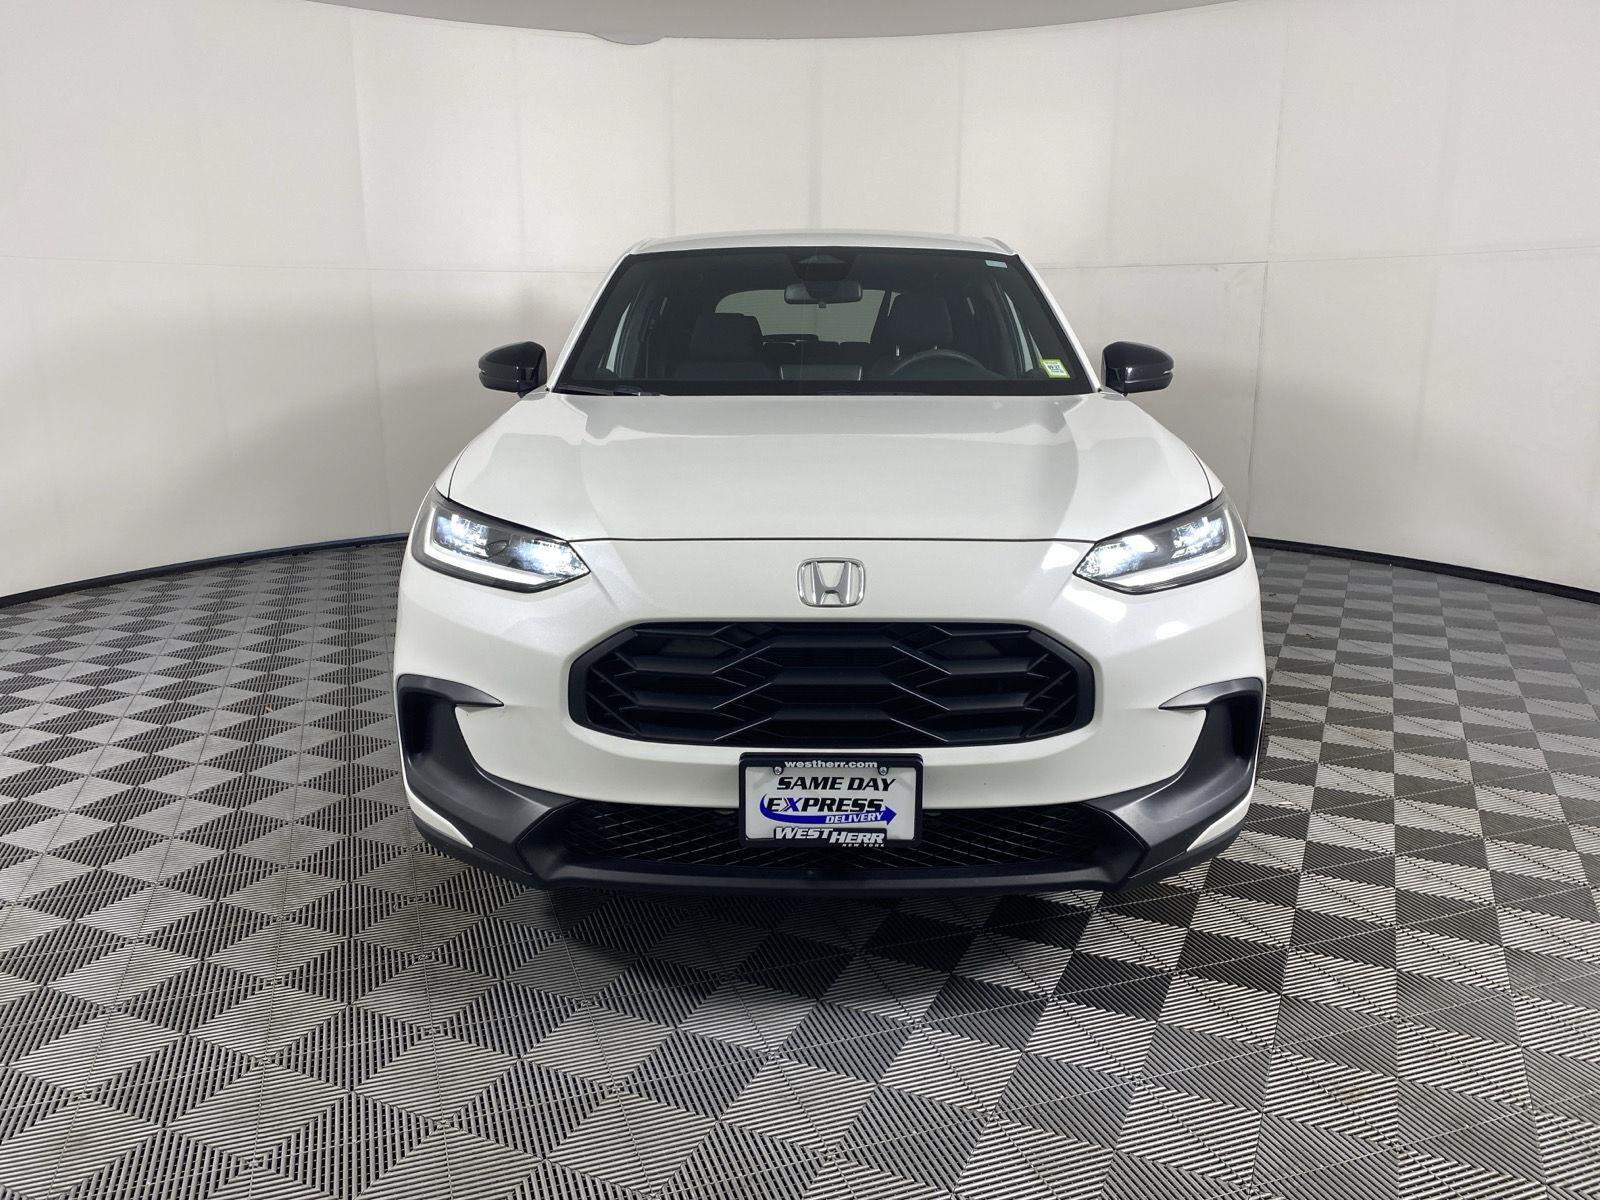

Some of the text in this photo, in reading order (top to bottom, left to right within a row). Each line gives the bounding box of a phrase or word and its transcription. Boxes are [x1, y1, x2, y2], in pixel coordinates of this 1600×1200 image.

[784, 760, 878, 768] westherr.com
[777, 776, 896, 791] SAME DAY
[766, 797, 884, 813] EXPRESS
[825, 812, 883, 824] DELIVERY
